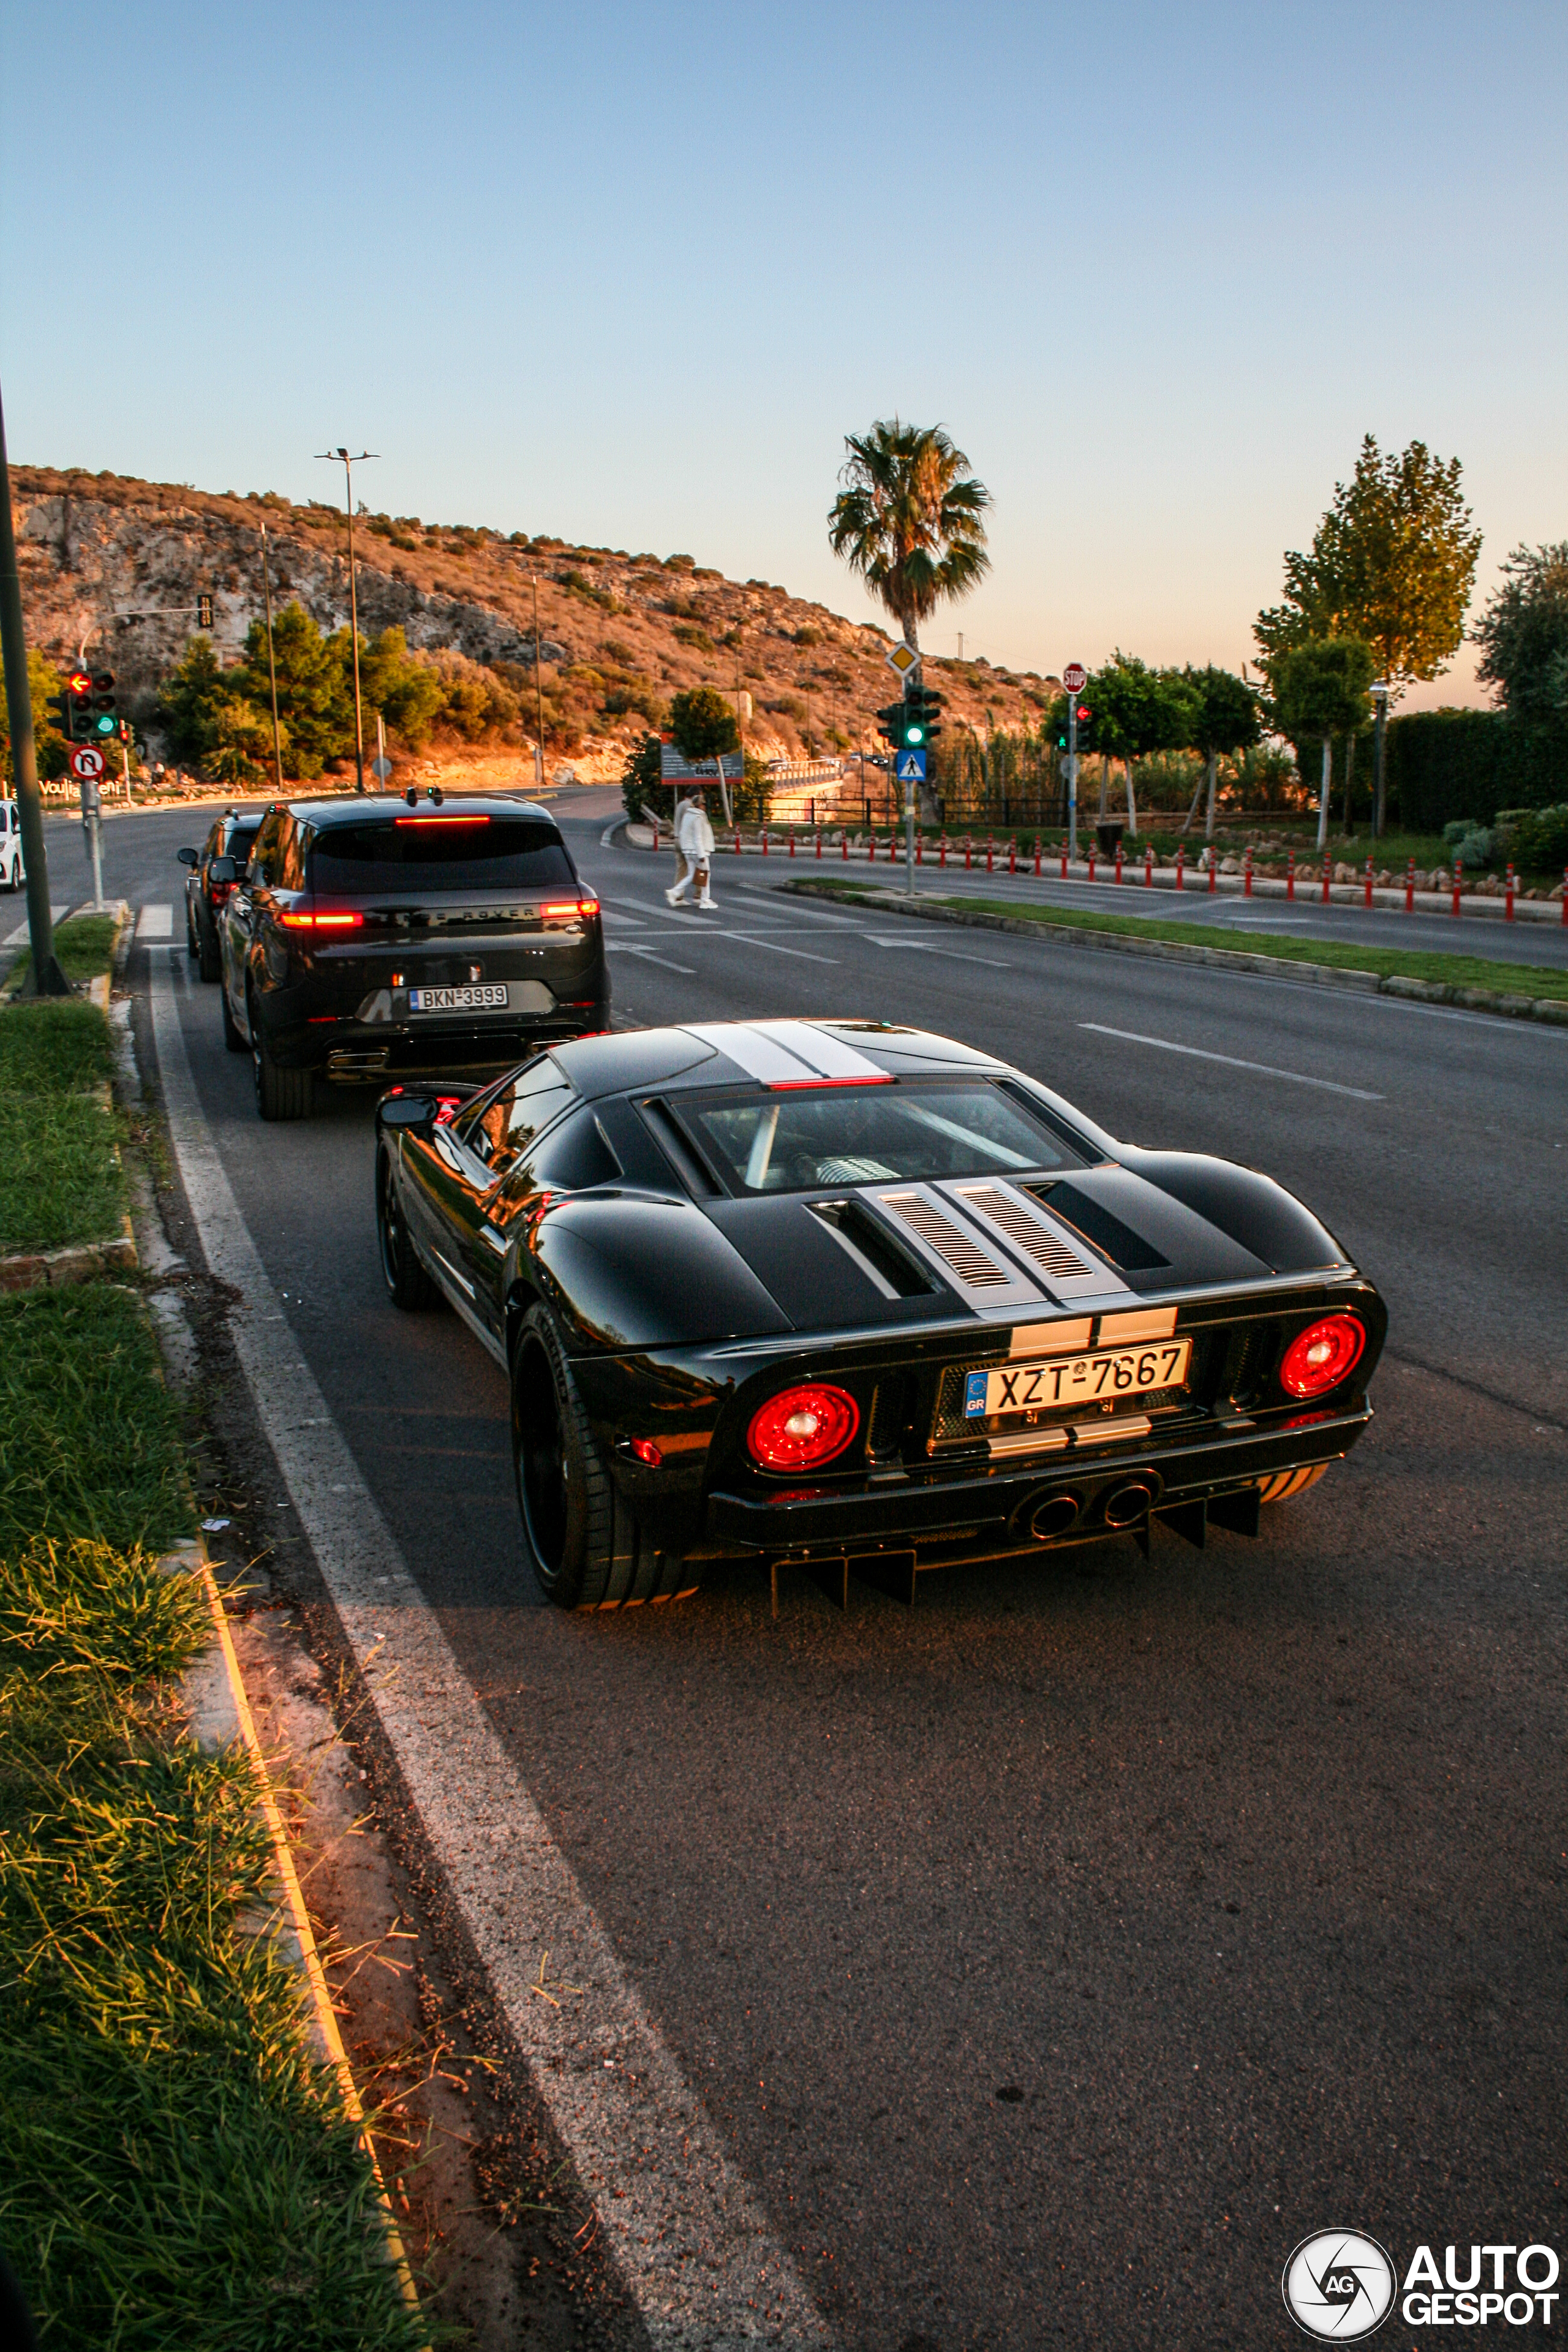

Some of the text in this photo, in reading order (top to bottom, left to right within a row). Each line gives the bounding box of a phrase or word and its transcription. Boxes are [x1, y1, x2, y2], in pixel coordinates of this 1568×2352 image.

[1065, 670, 1085, 686] STOP
[38, 777, 120, 801] Vouliaeni
[464, 909, 533, 919] ROVER
[424, 987, 504, 1008] BKN-3999
[998, 1348, 1181, 1408] XZT-7667
[967, 1400, 984, 1411] GR
